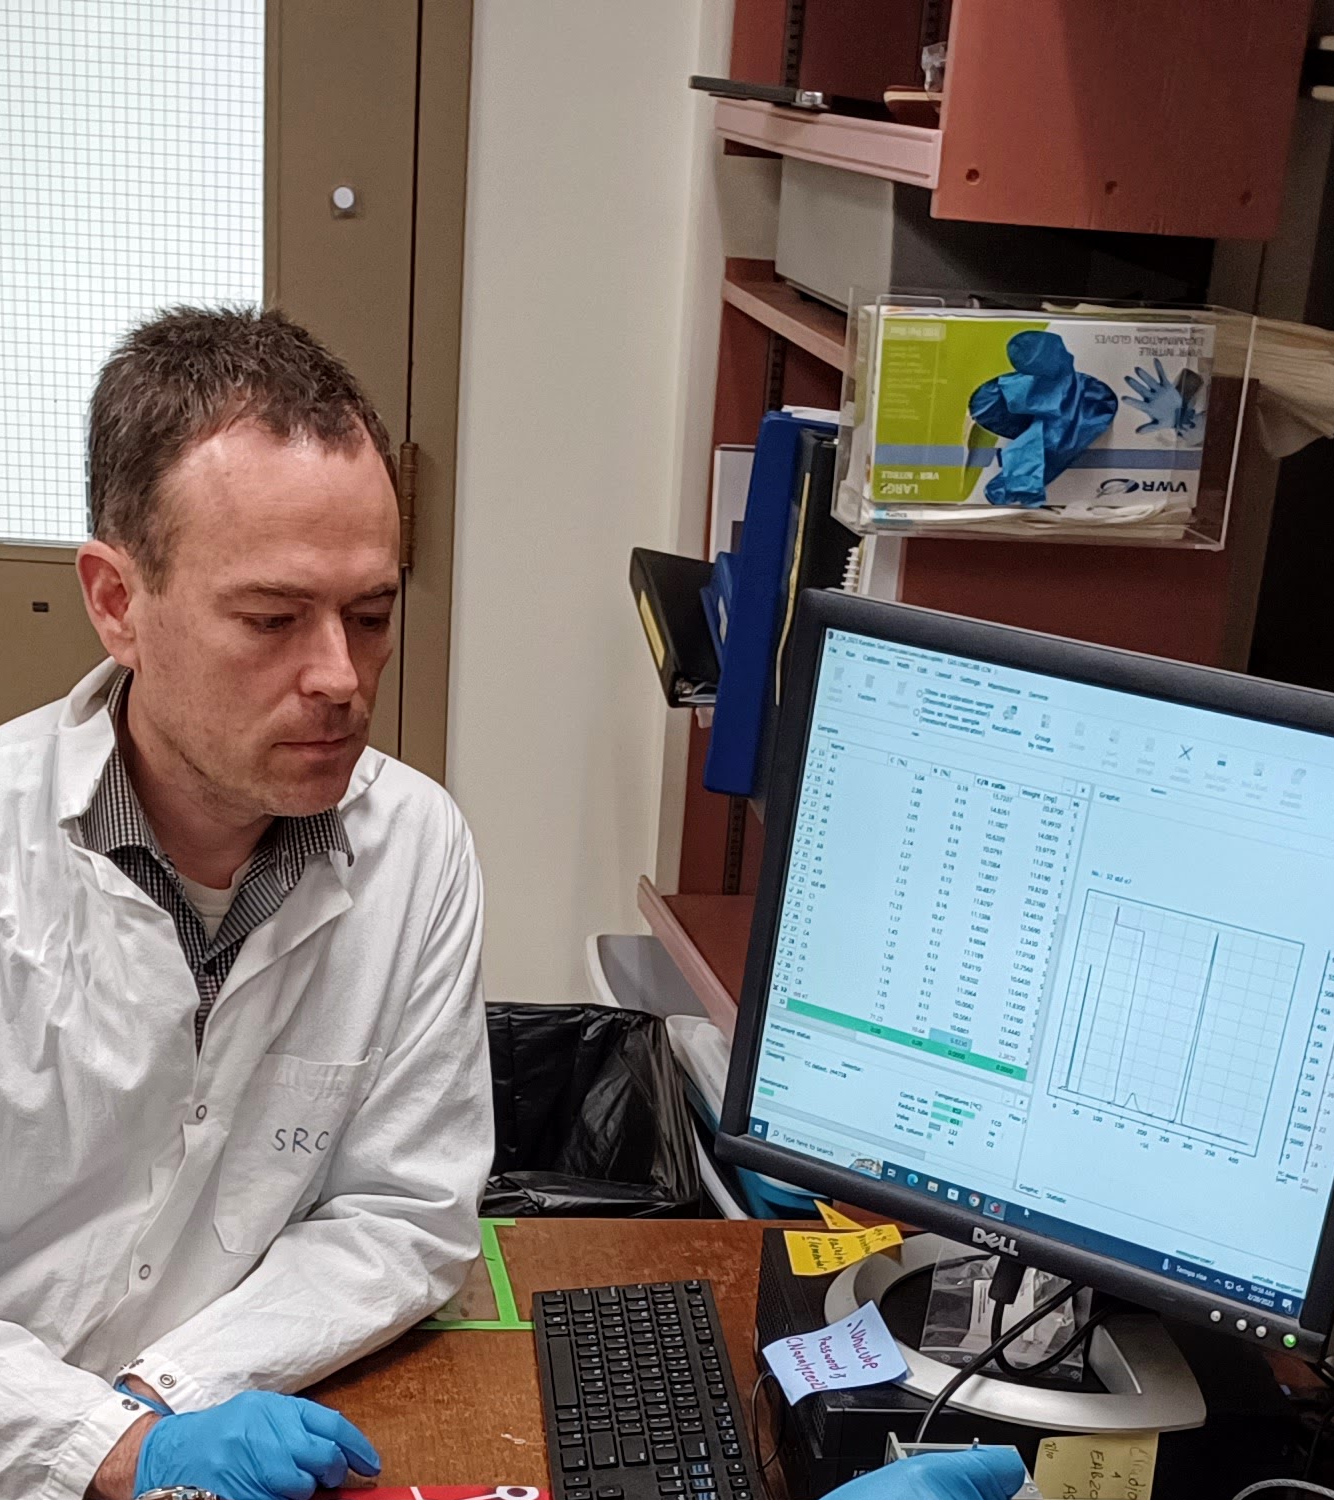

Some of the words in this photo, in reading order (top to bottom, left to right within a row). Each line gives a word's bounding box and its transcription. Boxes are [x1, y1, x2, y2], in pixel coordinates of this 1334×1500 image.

[1095, 334, 1132, 345] GLOVES
[1134, 335, 1204, 346] EXAMINATION
[1139, 346, 1175, 357] NITRILE
[1141, 478, 1188, 494] VWR
[271, 1128, 330, 1154] SRC
[972, 1226, 1019, 1257] DELL
[818, 1335, 847, 1372] Password
